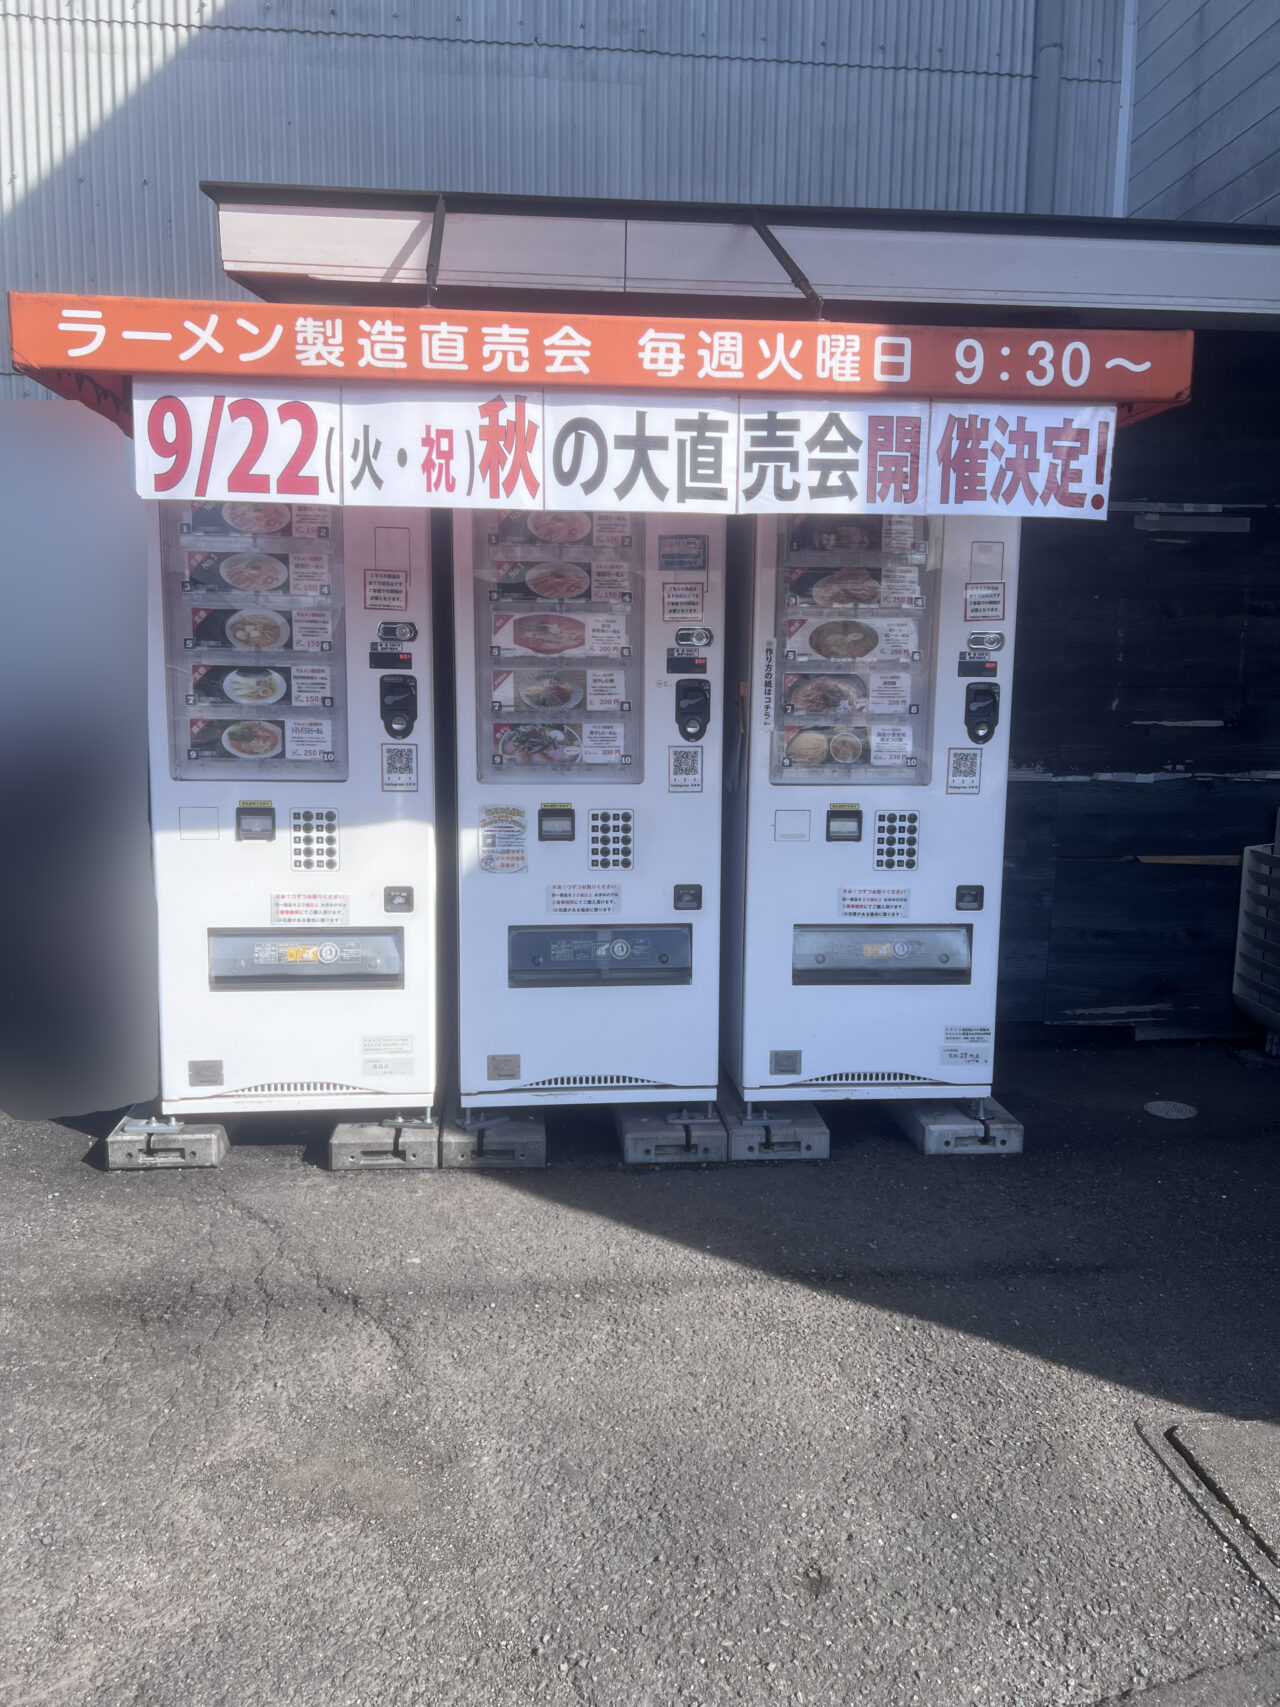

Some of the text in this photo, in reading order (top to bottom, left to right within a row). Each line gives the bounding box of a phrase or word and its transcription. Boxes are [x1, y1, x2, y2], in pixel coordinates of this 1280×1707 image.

[57, 308, 593, 375] ラーメン製造直売会
[637, 328, 912, 383] 毎週火曜日
[306, 640, 321, 648] 150
